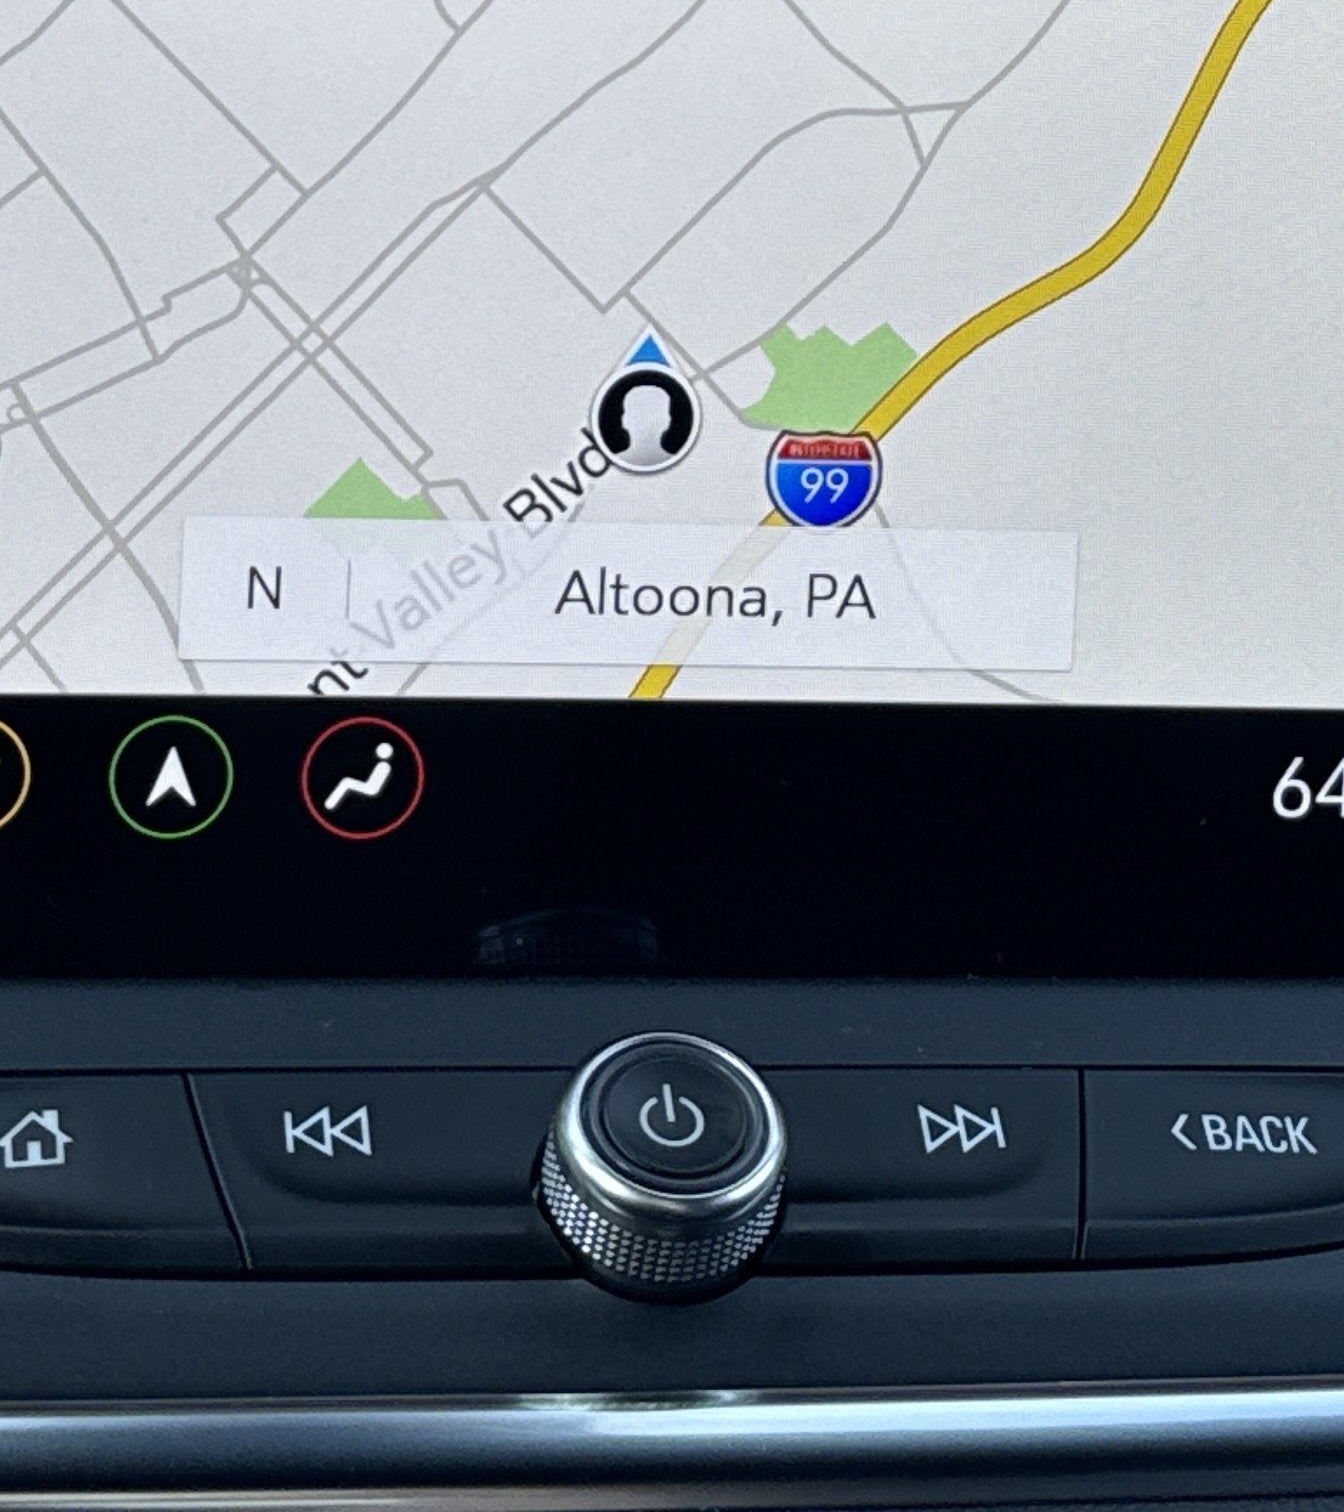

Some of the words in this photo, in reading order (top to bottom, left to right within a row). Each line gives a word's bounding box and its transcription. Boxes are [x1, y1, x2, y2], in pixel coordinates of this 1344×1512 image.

[800, 466, 849, 504] 99
[349, 529, 508, 650] Valley
[502, 426, 614, 540] Blvd
[246, 565, 283, 610] N
[554, 566, 784, 625] Altoona,
[806, 573, 877, 620] PA
